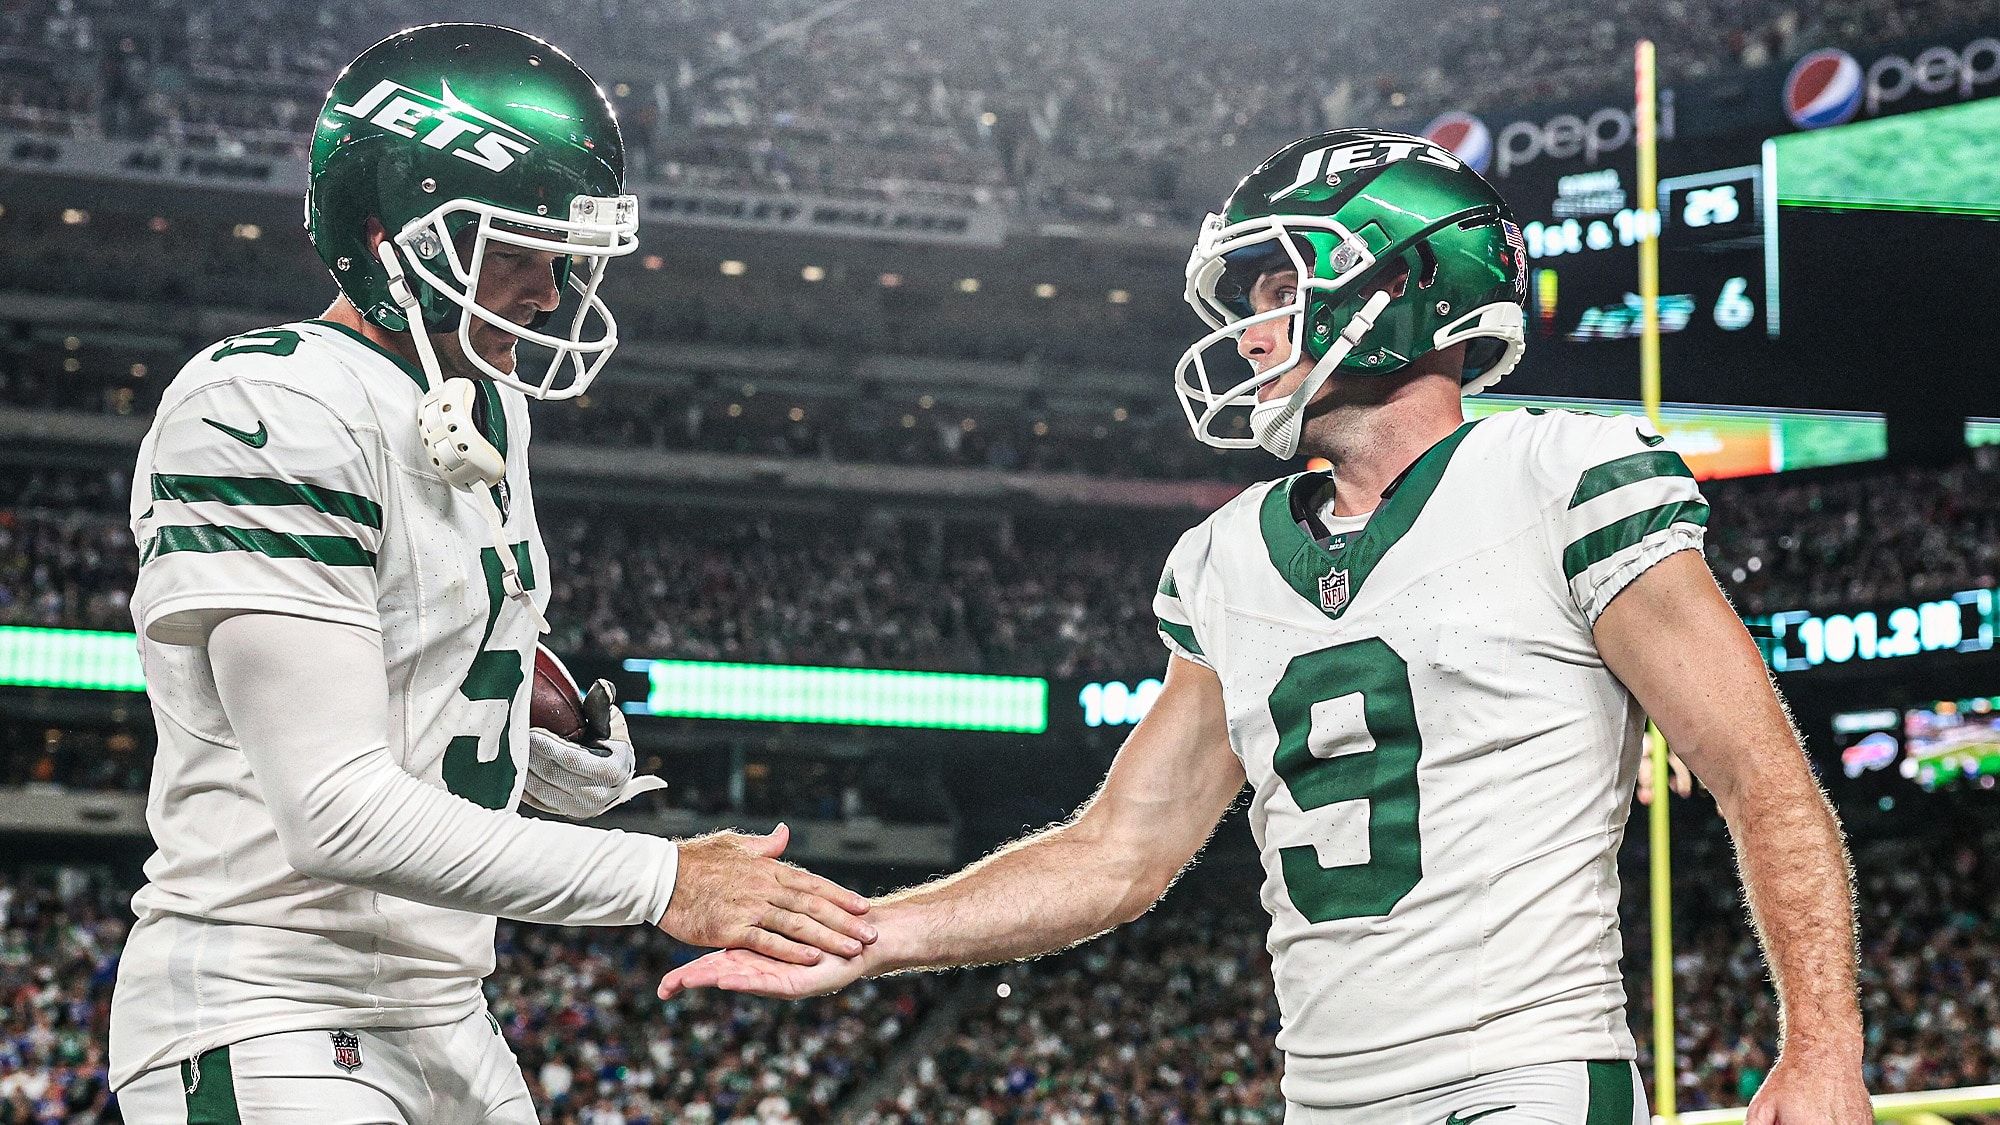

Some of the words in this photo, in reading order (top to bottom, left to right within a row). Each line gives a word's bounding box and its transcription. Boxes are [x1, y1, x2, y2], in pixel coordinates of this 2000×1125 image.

[333, 77, 540, 173] JETS
[1269, 134, 1461, 203] JETS
[1497, 88, 1676, 177] pepi
[1713, 276, 1755, 331] 6
[442, 541, 536, 810] 5
[1268, 636, 1423, 924] 9
